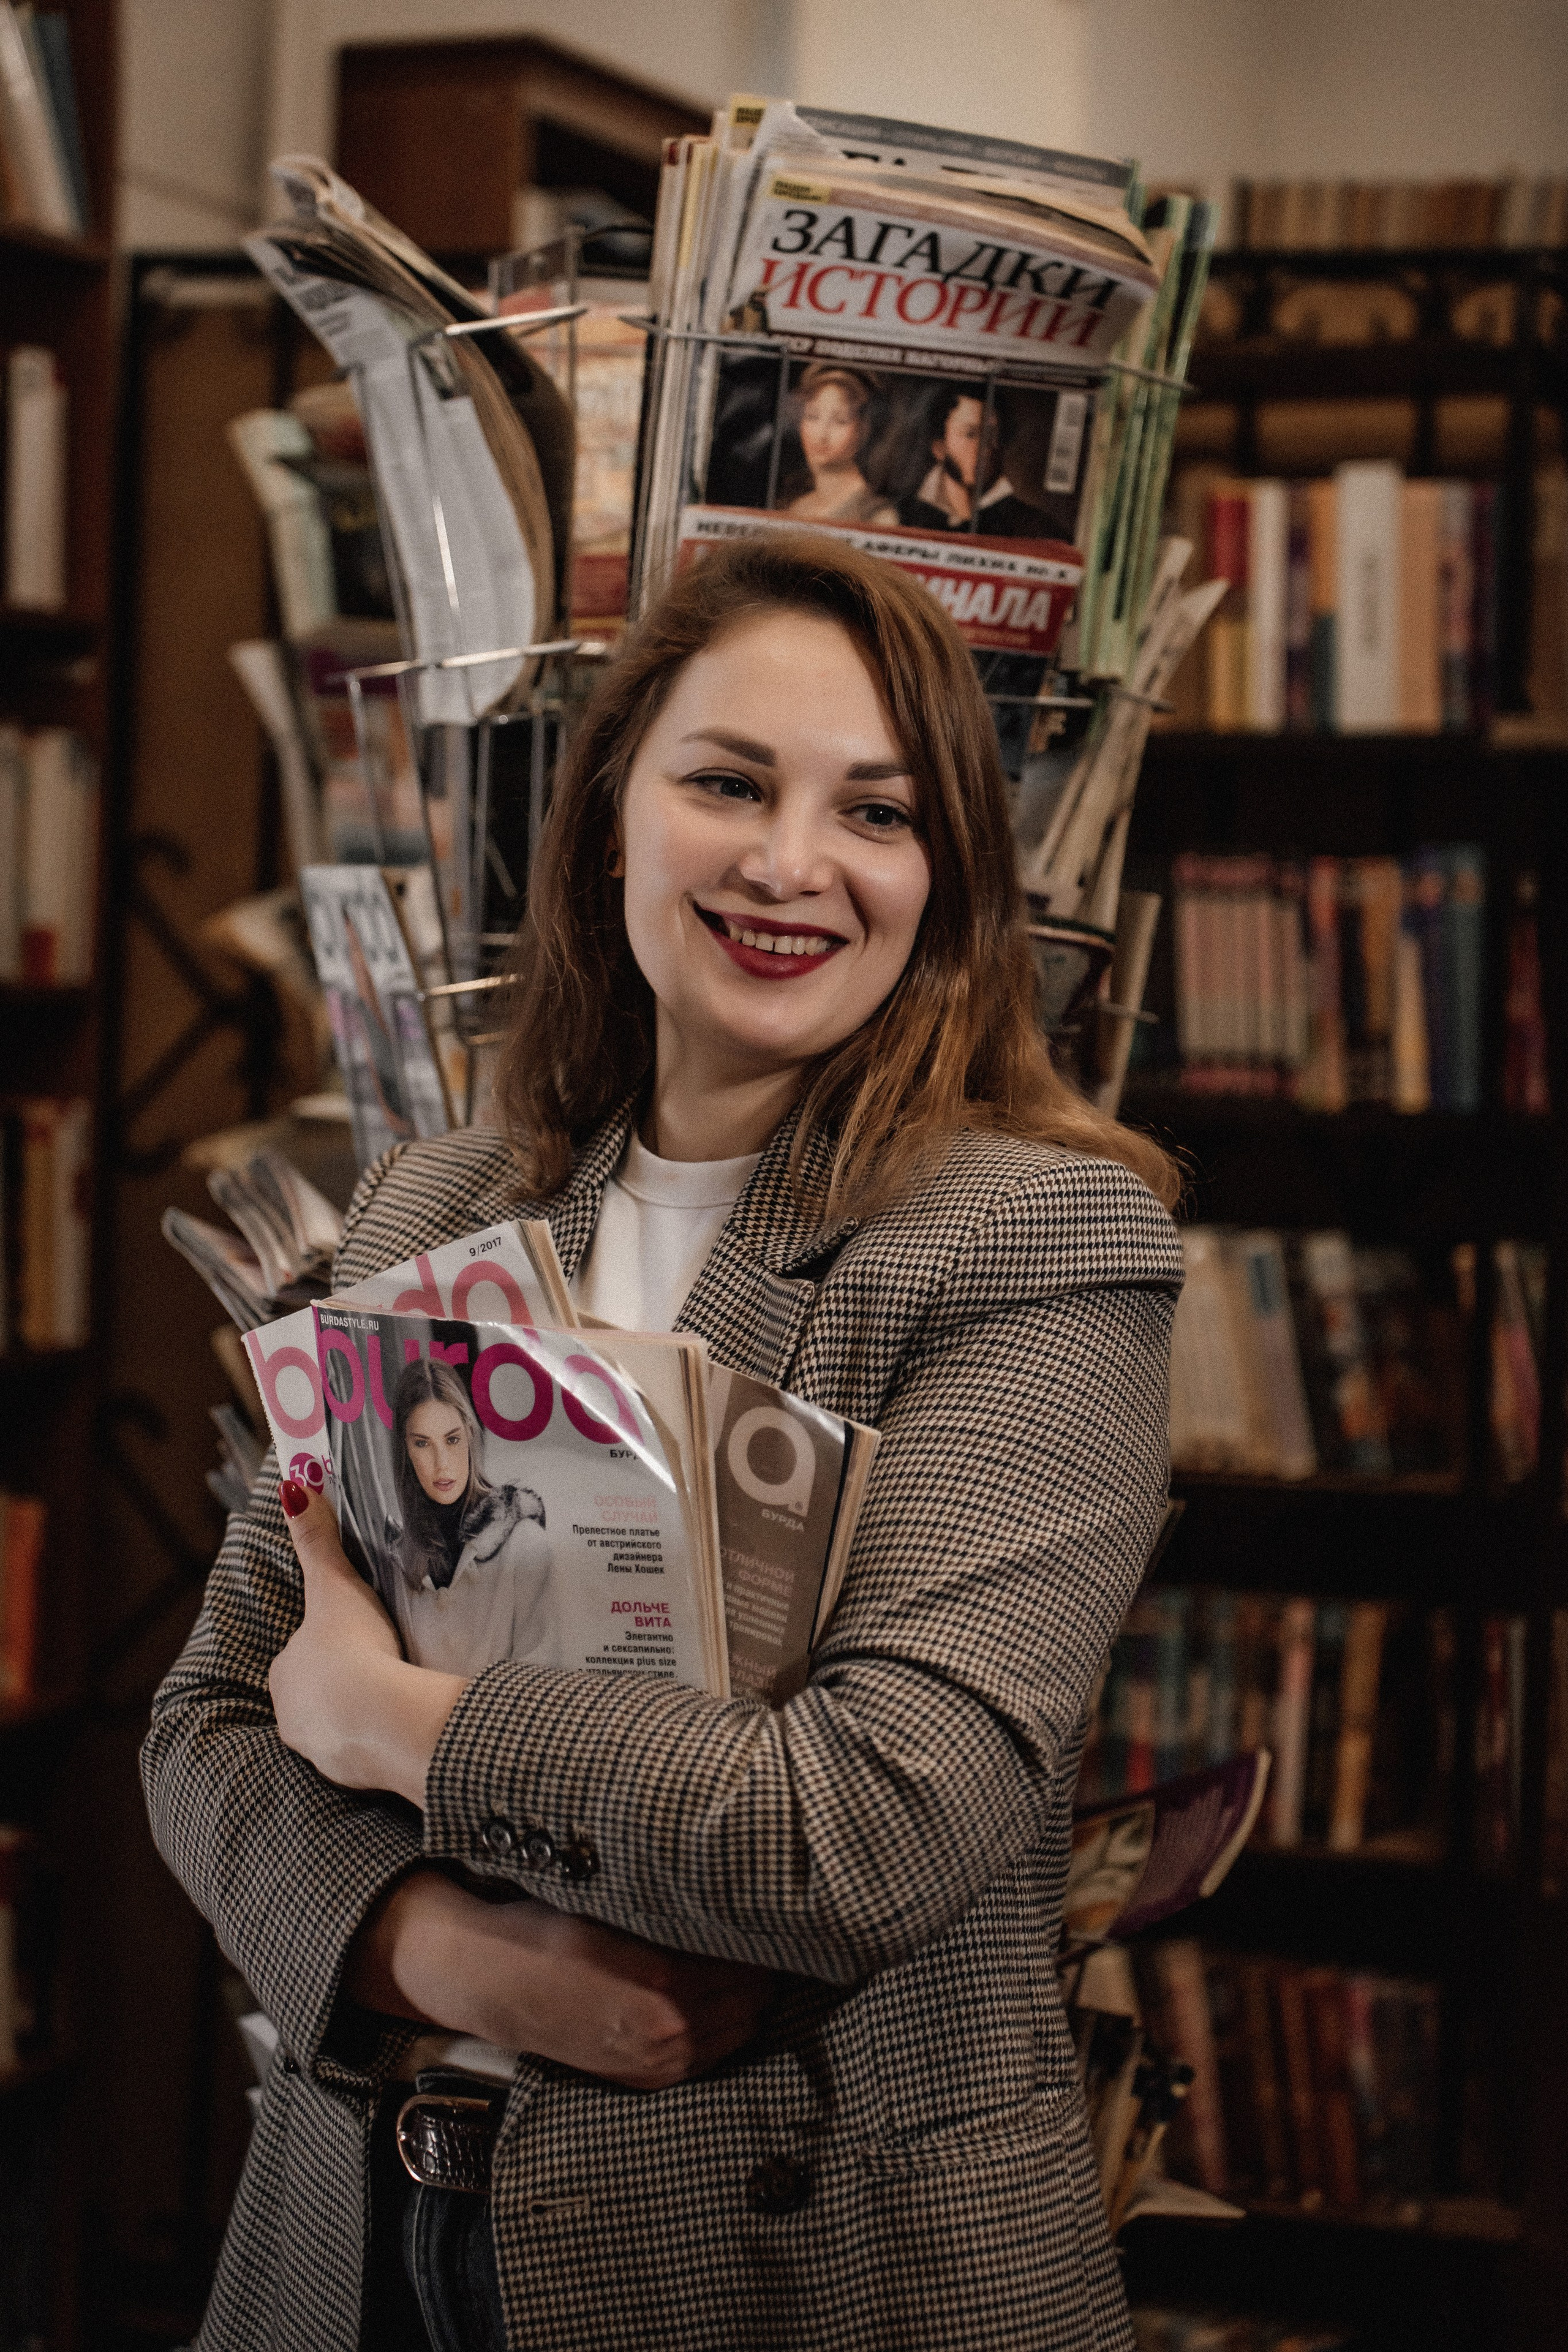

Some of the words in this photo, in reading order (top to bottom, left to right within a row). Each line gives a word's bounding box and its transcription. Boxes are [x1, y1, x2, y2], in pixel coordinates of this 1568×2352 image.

[771, 209, 1123, 310] ЗАГАДКИ
[760, 258, 1103, 348] ИСТОРИИ
[469, 1237, 502, 1256] 9/2017
[320, 1314, 379, 1331] BURDASTYLE.RU
[594, 1494, 657, 1507] ОСОБЫЙ
[601, 1509, 658, 1523] СЛУЧАЙ
[761, 1508, 805, 1531] БУРДА
[573, 1525, 627, 1536] Прелестное
[629, 1528, 660, 1537] платье
[600, 1539, 662, 1550] австрийского
[613, 1552, 663, 1563] дизайнера
[608, 1563, 632, 1573] Лены
[635, 1564, 665, 1574] Хошек
[611, 1601, 670, 1614] ДОЛЬЧЕ
[635, 1616, 671, 1627] ВИТА
[625, 1631, 674, 1642] Элегантно
[612, 1645, 674, 1654] сексапильно:
[586, 1656, 635, 1666] коллекция
[637, 1657, 656, 1667] plus
[658, 1657, 677, 1667] size
